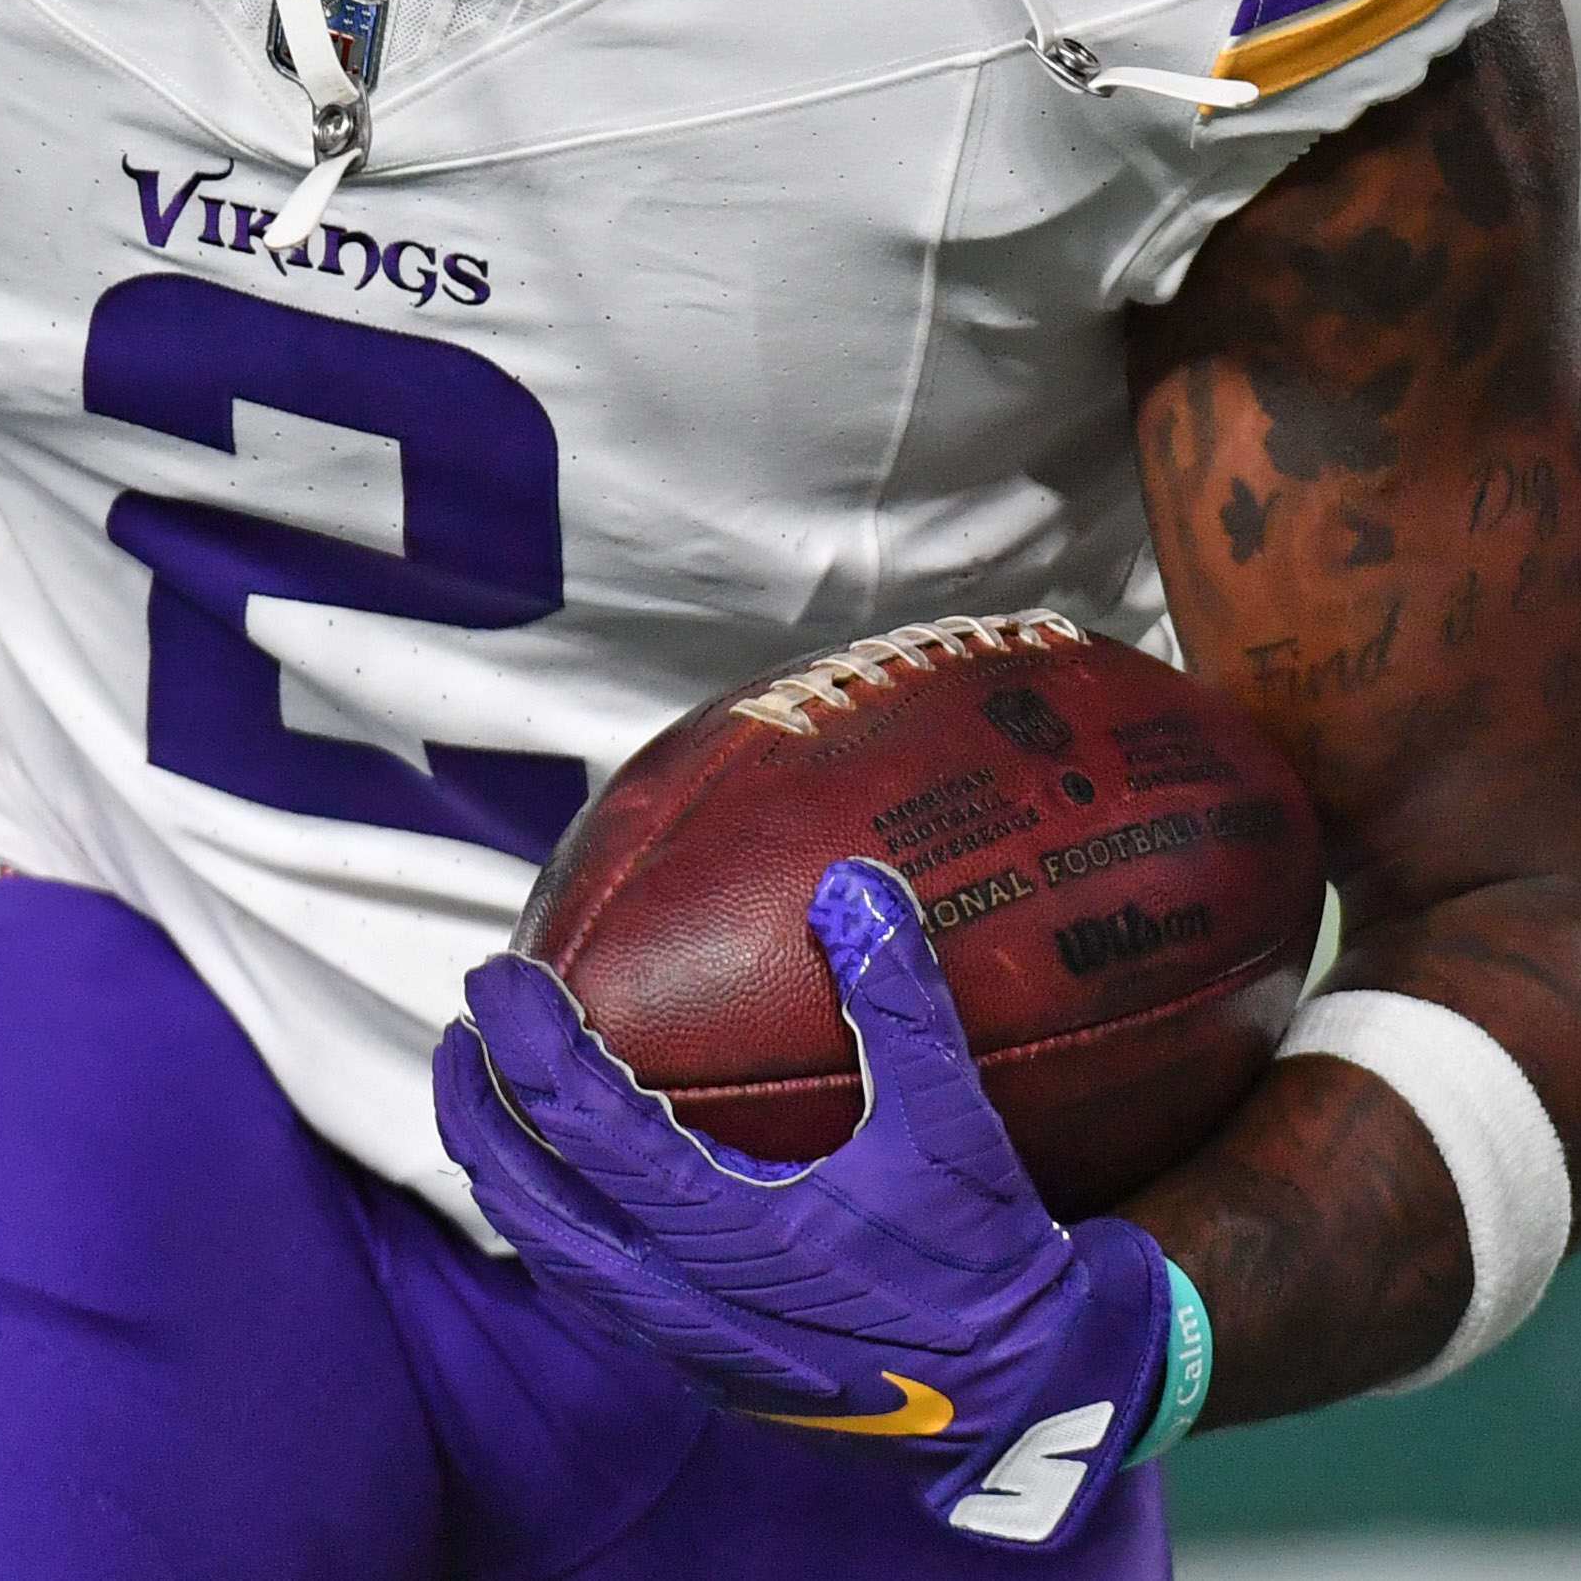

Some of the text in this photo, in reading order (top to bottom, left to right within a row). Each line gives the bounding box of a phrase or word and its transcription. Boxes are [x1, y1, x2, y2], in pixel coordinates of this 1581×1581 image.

[83, 272, 587, 866] 2
[874, 765, 995, 832] AMERICAN
[888, 792, 1013, 854] FOOTBALL
[901, 805, 1040, 877] ONFERENCE
[924, 869, 1035, 933] IONAL
[1043, 816, 1204, 884] FOOTBALL
[1177, 1304, 1202, 1407] Calm
